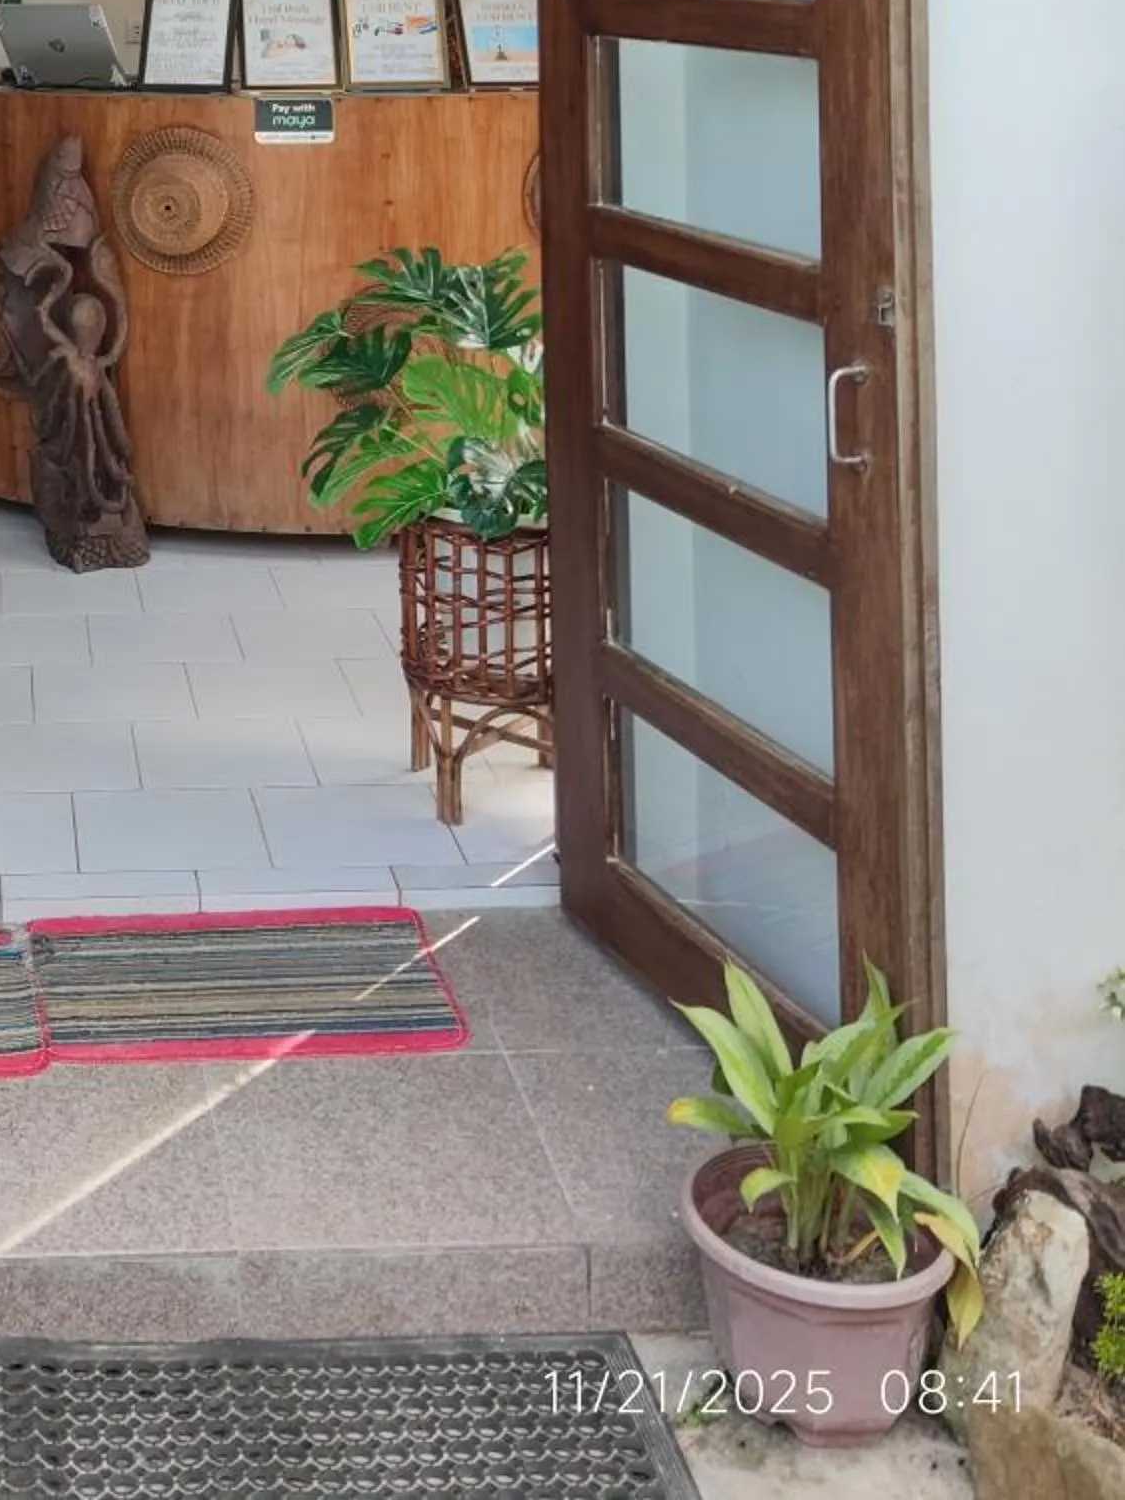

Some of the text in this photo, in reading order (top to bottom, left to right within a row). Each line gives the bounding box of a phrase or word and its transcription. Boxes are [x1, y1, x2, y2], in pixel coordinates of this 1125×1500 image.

[272, 103, 315, 114] Pay with
[272, 115, 315, 128] maya
